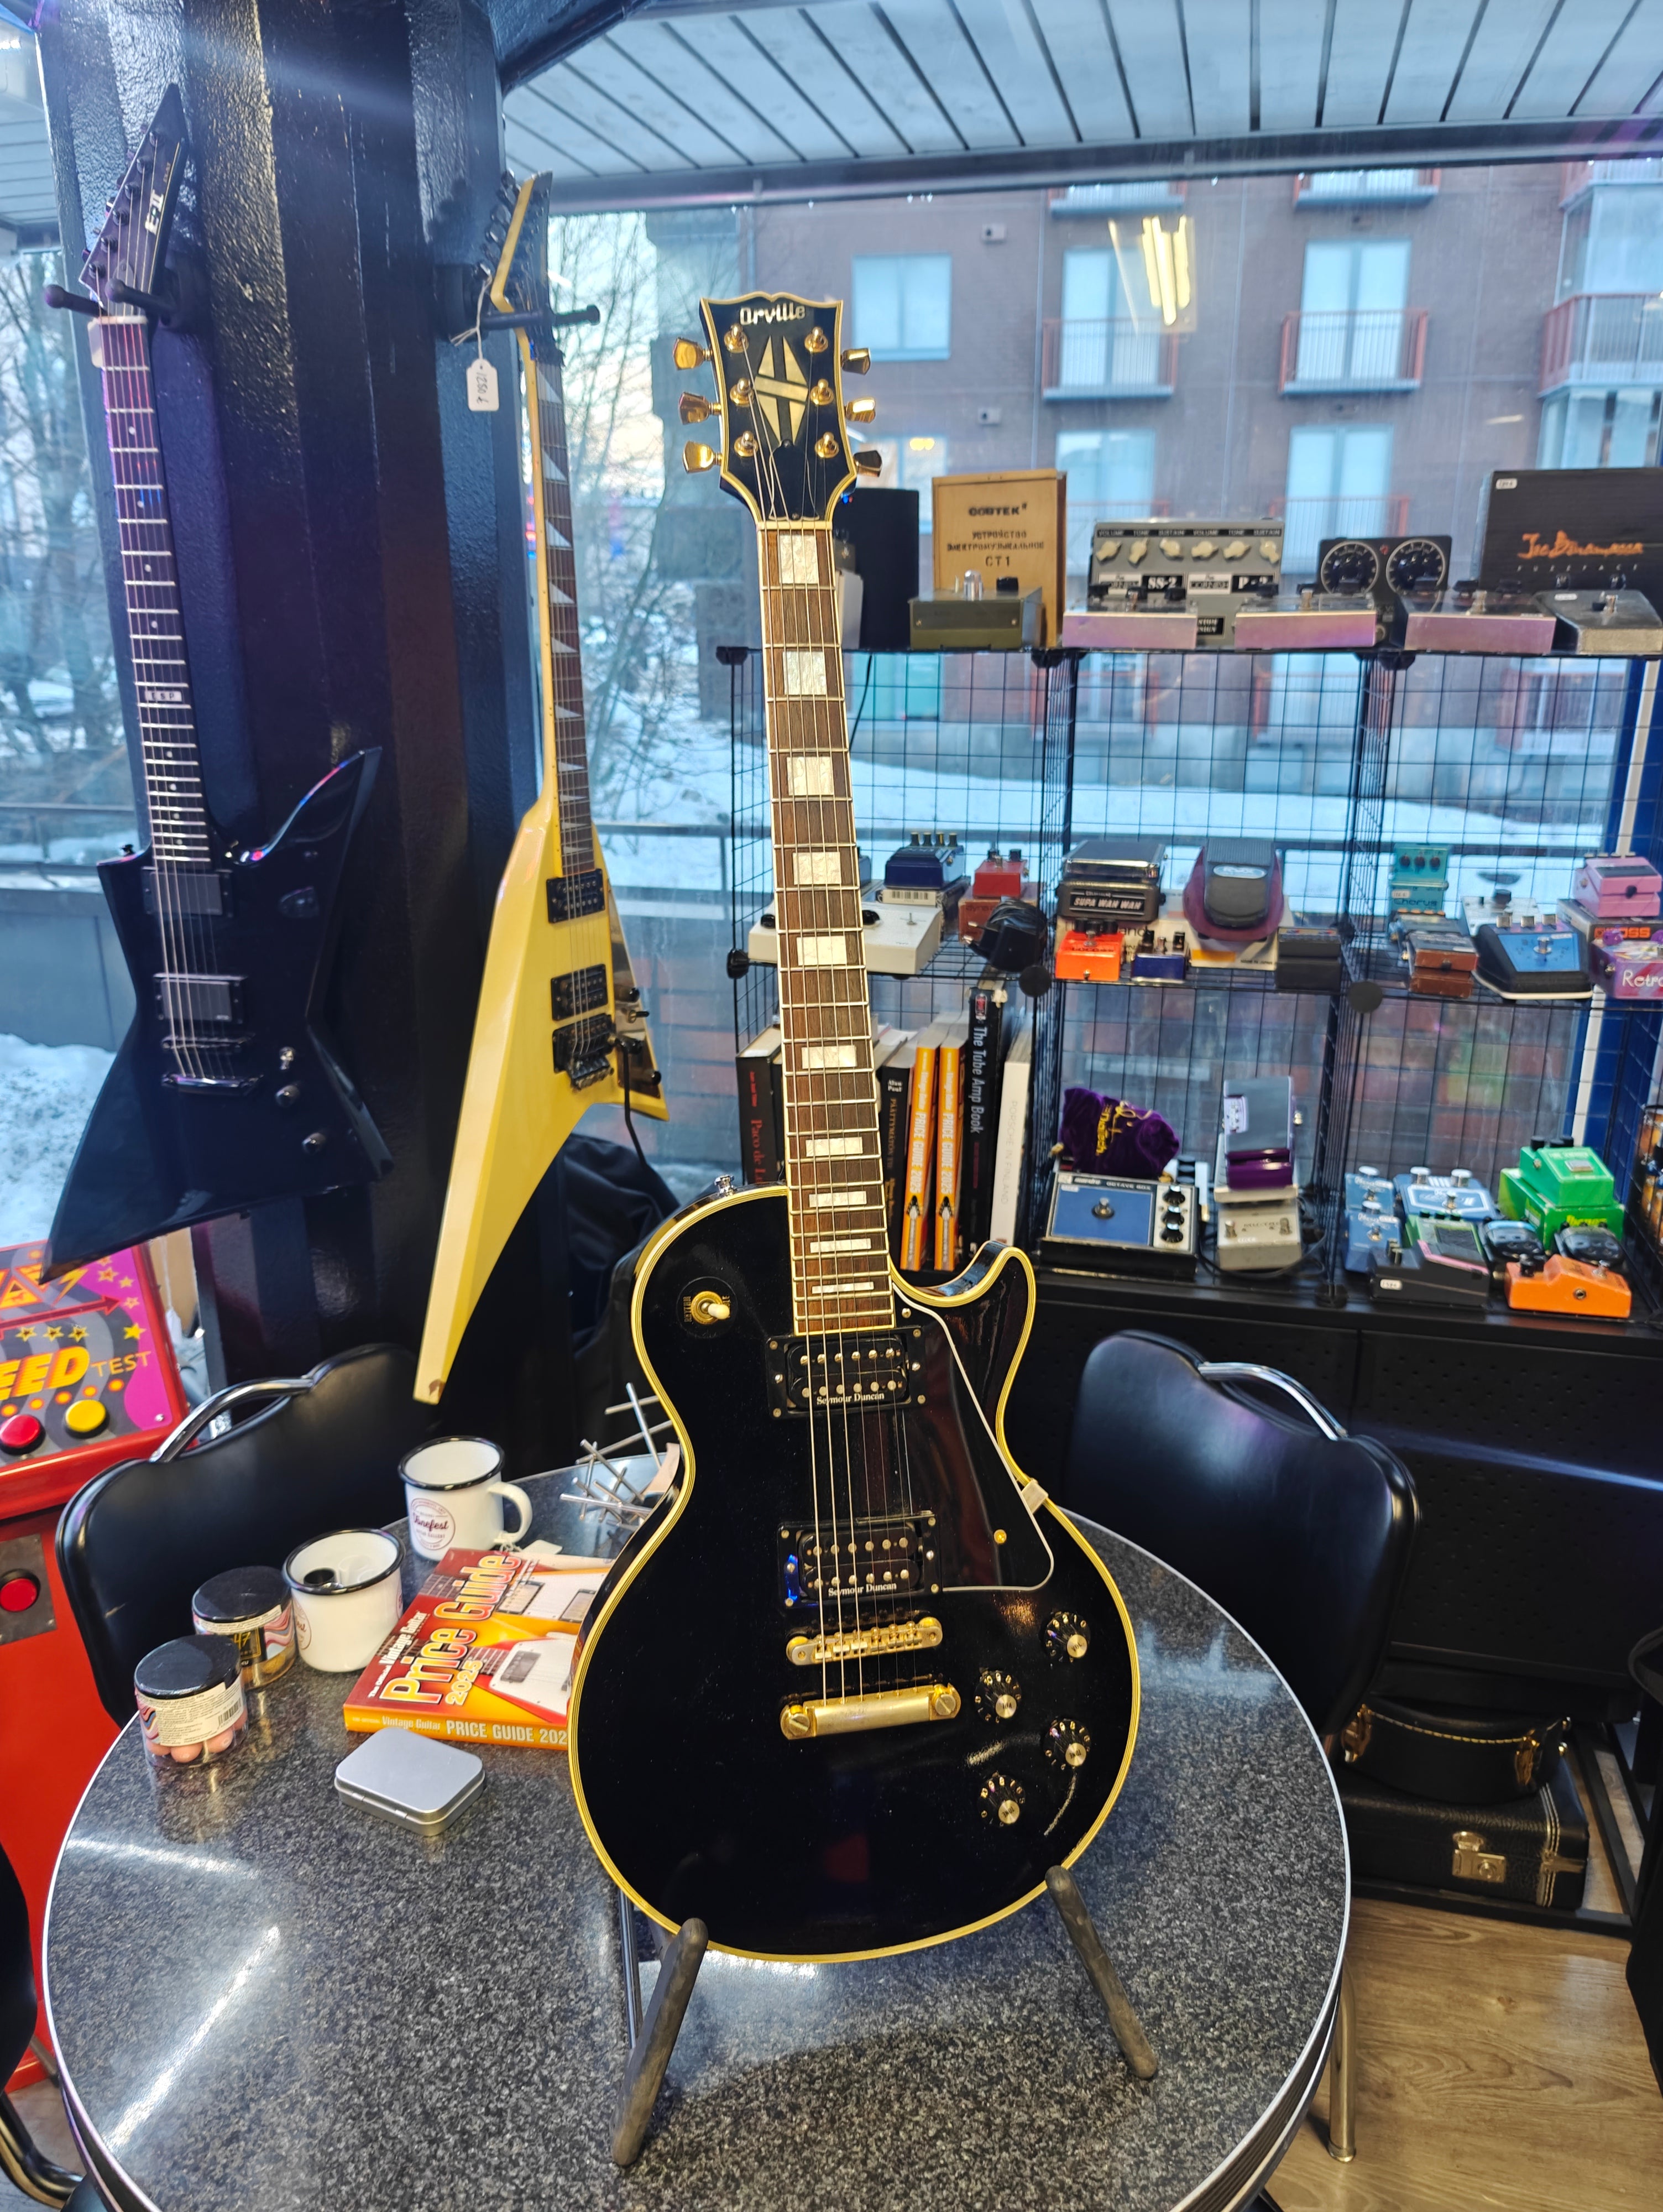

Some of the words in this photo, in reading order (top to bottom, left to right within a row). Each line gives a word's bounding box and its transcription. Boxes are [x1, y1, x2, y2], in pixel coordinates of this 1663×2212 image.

[740, 302, 806, 325] Orville
[1074, 898, 1096, 907] SUPA
[1098, 899, 1120, 909] WAH
[1120, 900, 1142, 910] WAH
[1394, 898, 1437, 906] Chorus
[973, 1027, 987, 1047] The
[972, 1050, 987, 1076] Tube
[968, 1078, 986, 1103] Amp
[751, 1119, 762, 1148] Paco
[913, 1112, 927, 1139] PRICE
[942, 1113, 954, 1139] PRICE
[970, 1107, 985, 1134] Book
[1006, 1101, 1018, 1146] PORSCHE
[753, 1150, 765, 1165] de
[912, 1141, 924, 1168] GUIDE
[942, 1141, 954, 1168] GUIDE
[1005, 1150, 1012, 1159] IN
[909, 1169, 922, 1194] 2025
[941, 1170, 953, 1194] 2025
[1001, 1163, 1012, 1205] FINLAND
[92, 1351, 151, 1378] TEST
[817, 1394, 852, 1406] Seymour
[854, 1392, 885, 1402] Duncan
[828, 1585, 864, 1597] Seymour
[866, 1583, 897, 1593] Duncan
[379, 1627, 477, 1704] Price
[434, 1554, 522, 1621] Guide
[379, 1633, 415, 1665] Vintage
[401, 1610, 427, 1635] Guitar
[444, 1659, 484, 1706] 2025
[382, 1715, 414, 1730] Vintage
[416, 1719, 441, 1730] Guitar
[446, 1720, 487, 1738] PRICE
[493, 1724, 534, 1743] GUIDE
[539, 1728, 567, 1745] 202
